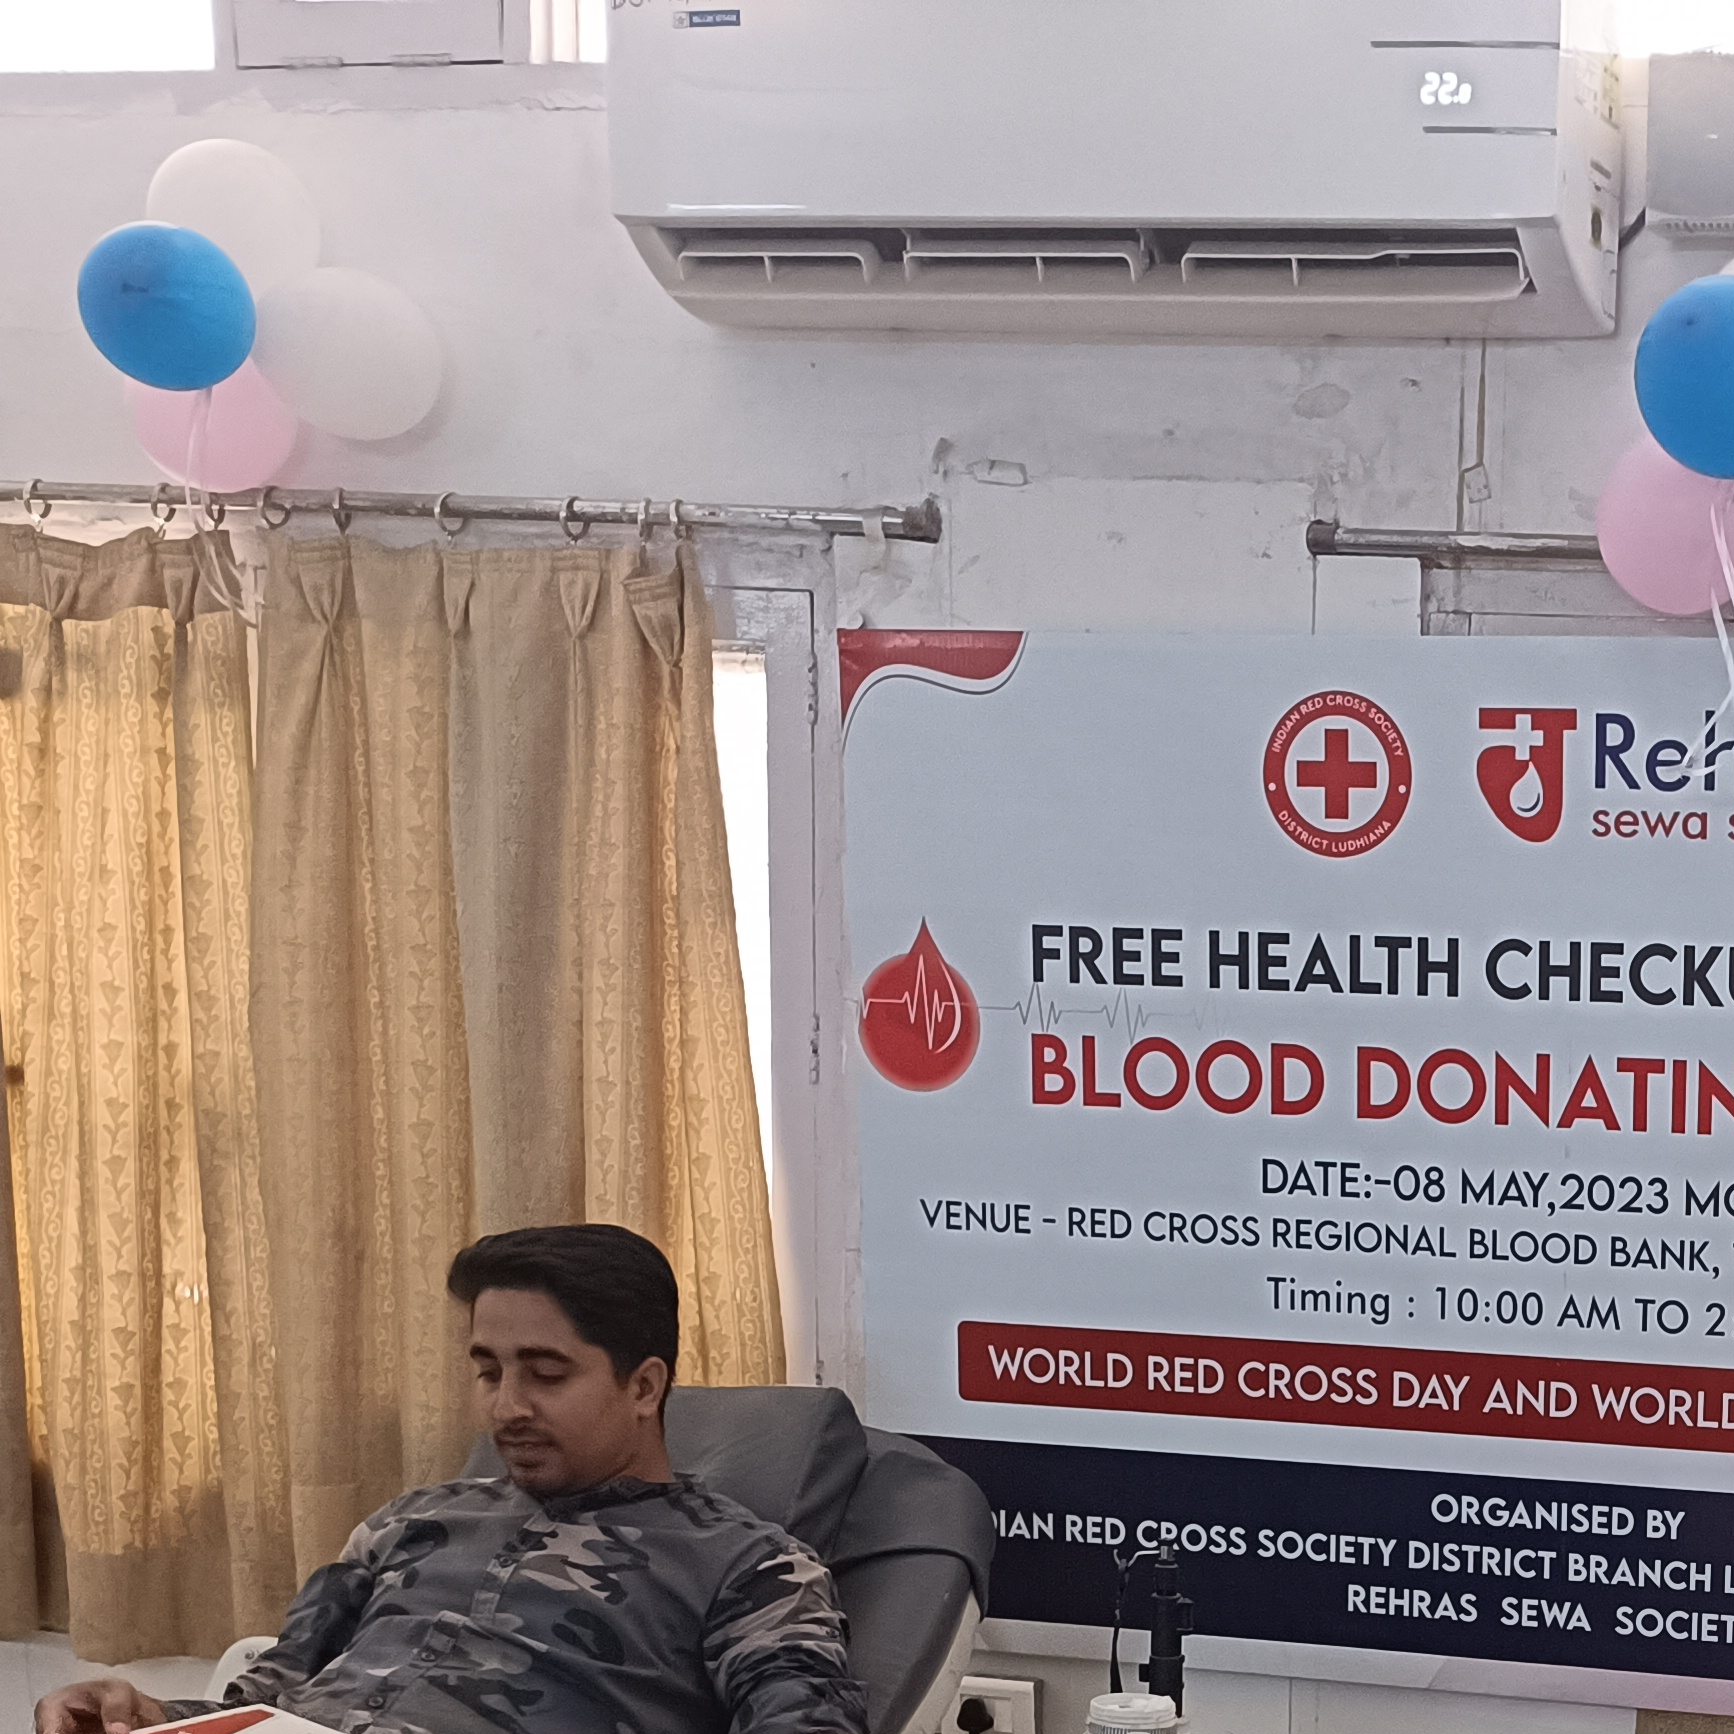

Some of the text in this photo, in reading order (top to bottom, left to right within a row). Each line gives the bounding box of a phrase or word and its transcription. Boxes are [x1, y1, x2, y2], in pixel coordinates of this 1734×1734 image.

[1271, 694, 1404, 757] INDIAN RED CROSS SOCIETY
[1278, 810, 1392, 852] DISTRICT LUDHIANA
[1591, 809, 1708, 840] sewa
[1031, 923, 1184, 988] FREE
[1208, 929, 1460, 998] HEALTH
[1030, 1032, 1325, 1116] BLOOD
[919, 1198, 1032, 1235] VENUE
[1068, 1206, 1132, 1239] RED
[1143, 1211, 1260, 1247] CROSS
[1272, 1217, 1457, 1258] REGIONAL
[1469, 1228, 1598, 1265] BLOOD
[1610, 1235, 1720, 1280] BANK,
[1266, 1276, 1390, 1325] Timing
[1435, 1286, 1544, 1326] 10:00
[1556, 1293, 1621, 1331] AM
[1634, 1298, 1689, 1335] TO
[987, 1344, 1133, 1388] WORLD
[1147, 1355, 1225, 1394] RED
[1237, 1361, 1378, 1405] CROSS
[1392, 1370, 1471, 1411] DAY
[1482, 1378, 1578, 1418] AND
[1430, 1493, 1686, 1540] ORGANISED BY
[990, 1509, 1054, 1540] IAN
[1065, 1514, 1126, 1545] RED
[1136, 1519, 1247, 1556] CROSS
[1256, 1528, 1397, 1567] SOCIETY
[1408, 1540, 1557, 1580] DISTRICT
[1568, 1552, 1712, 1593] BRANCH
[1347, 1583, 1478, 1623] REHRAS
[1500, 1596, 1592, 1632] SEWA
